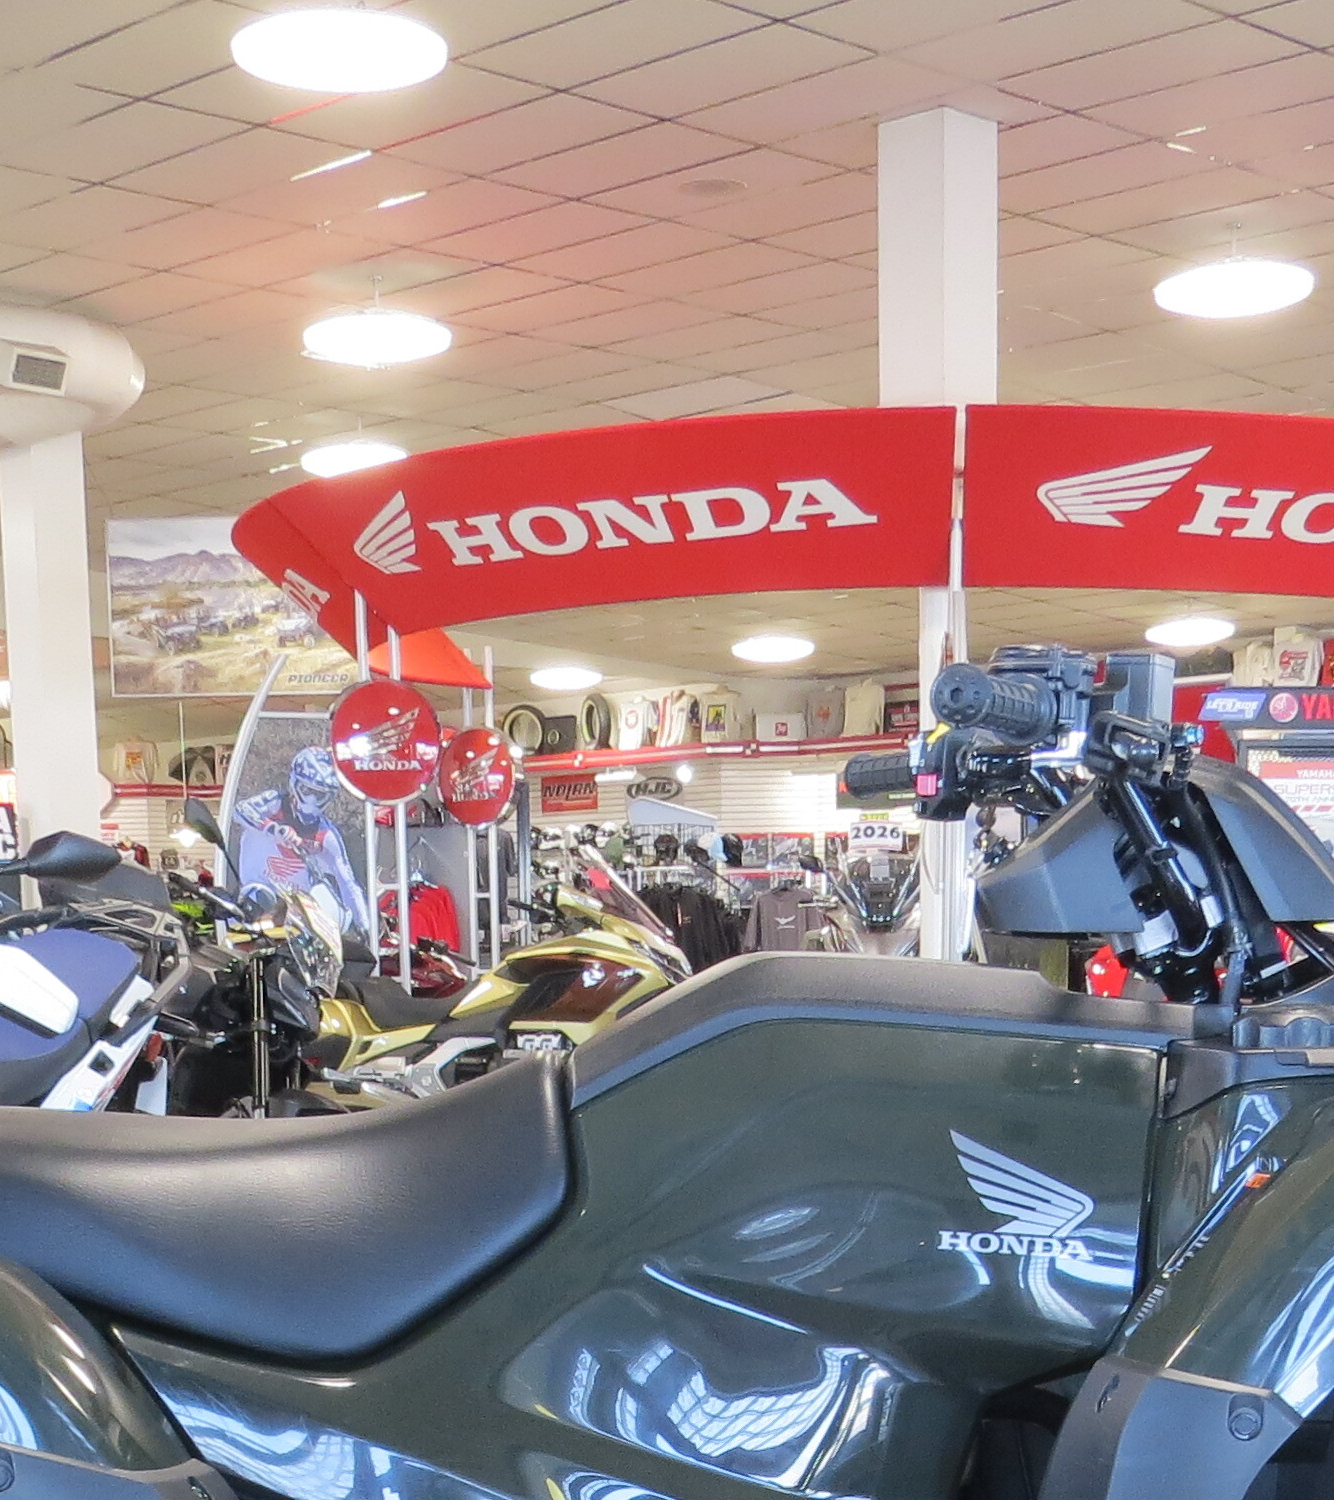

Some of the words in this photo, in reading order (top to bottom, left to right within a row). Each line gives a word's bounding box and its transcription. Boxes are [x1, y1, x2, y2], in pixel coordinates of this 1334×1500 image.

[428, 478, 877, 566] HONDA
[288, 673, 349, 684] PIONEER
[353, 759, 423, 772] HONDA
[543, 782, 598, 801] NOLAN
[635, 781, 673, 795] HJC
[852, 825, 901, 840] 2026
[937, 1230, 1094, 1261] HONDA
